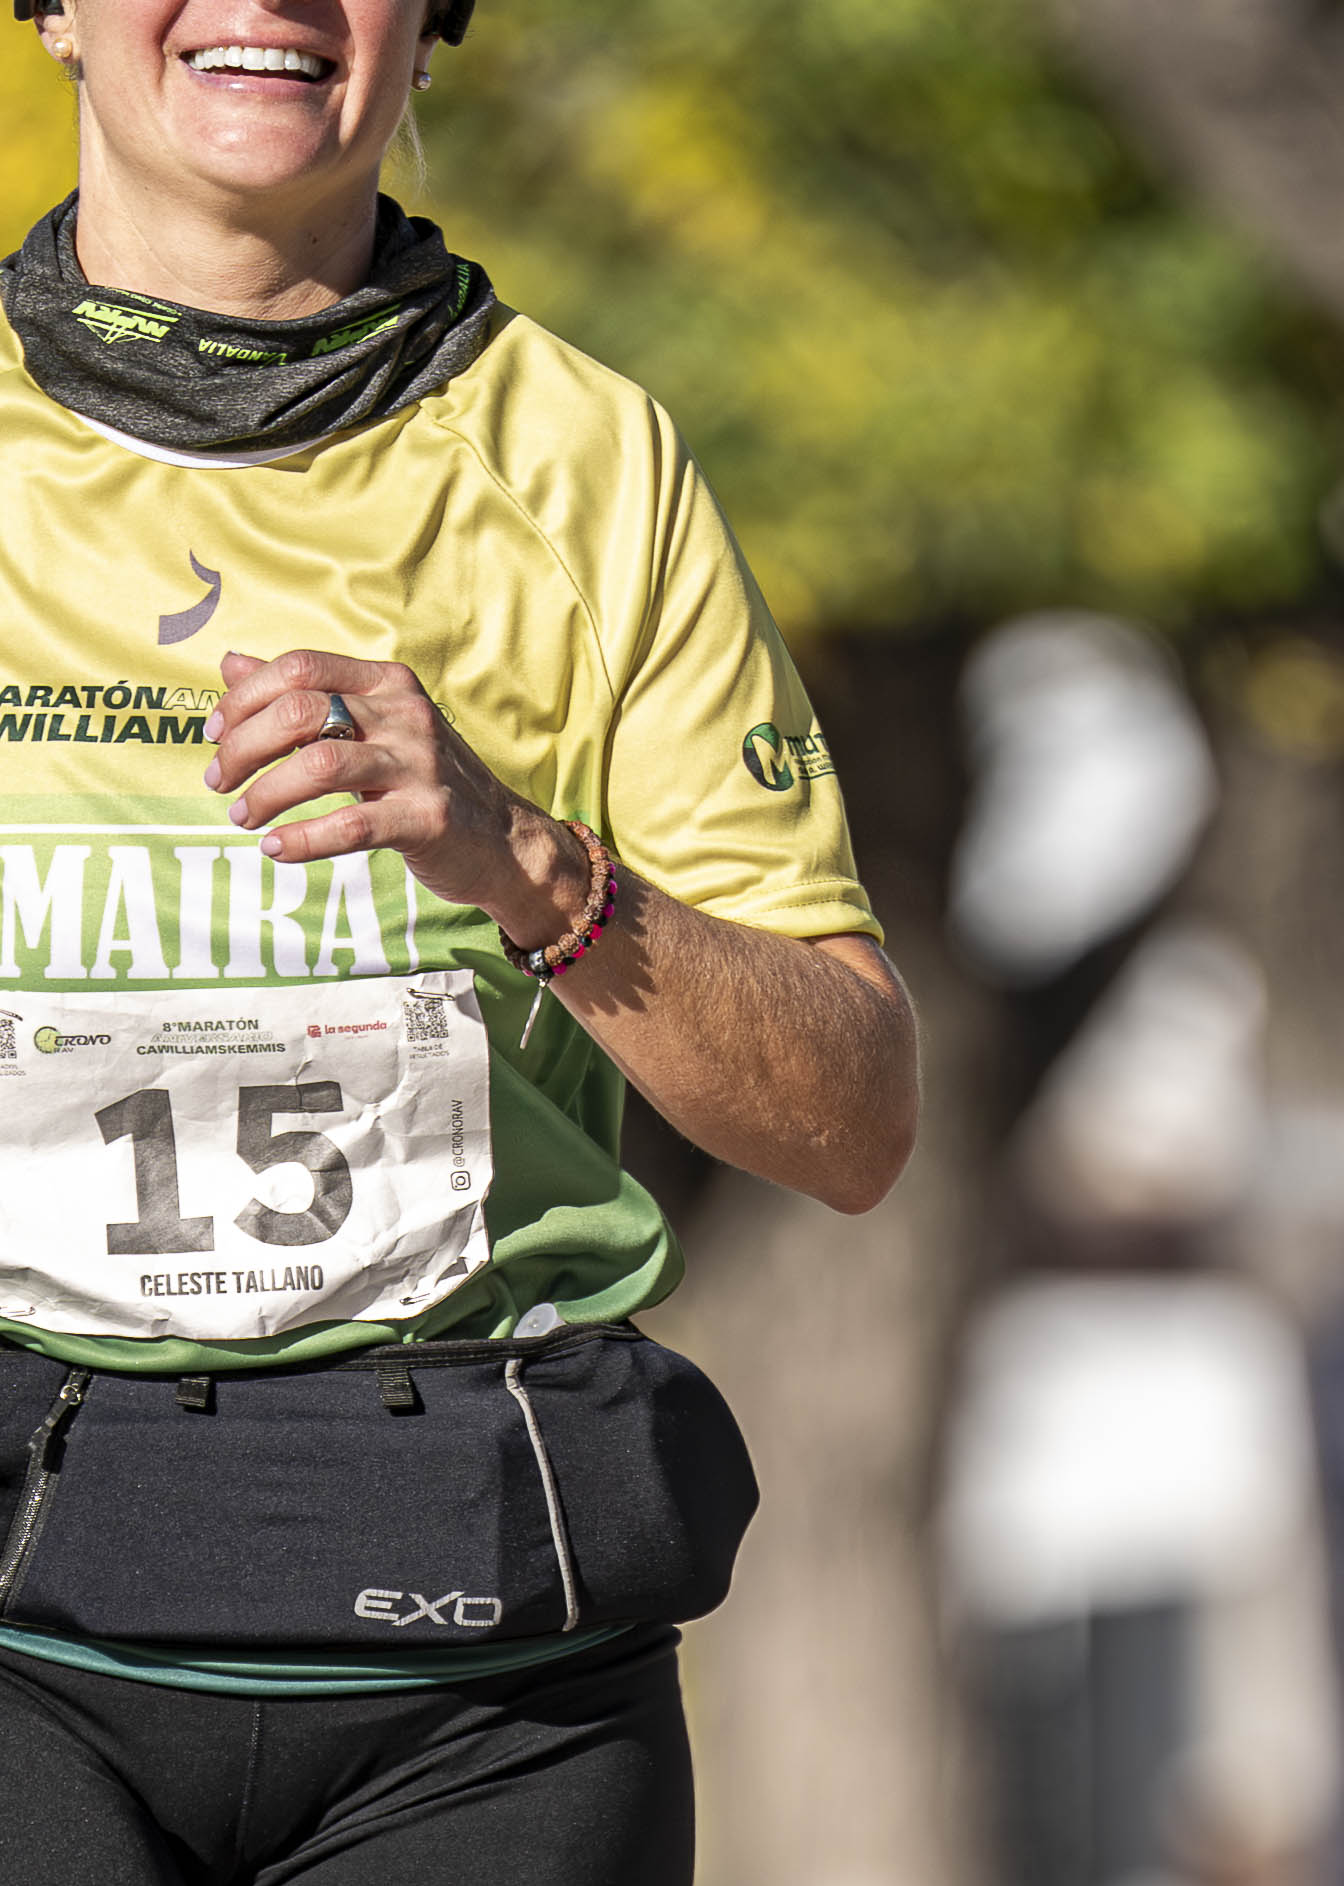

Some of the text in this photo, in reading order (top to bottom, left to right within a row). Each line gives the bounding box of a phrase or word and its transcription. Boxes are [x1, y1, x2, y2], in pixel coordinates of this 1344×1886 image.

[325, 1020, 387, 1034] la segunda
[136, 1043, 286, 1055] CAWILLIAMSKEMMIS
[452, 1099, 465, 1167] @CRONORAV
[94, 1079, 353, 1255] 15
[140, 1264, 324, 1298] CELESTE TALLANO
[354, 1588, 503, 1627] EXO
